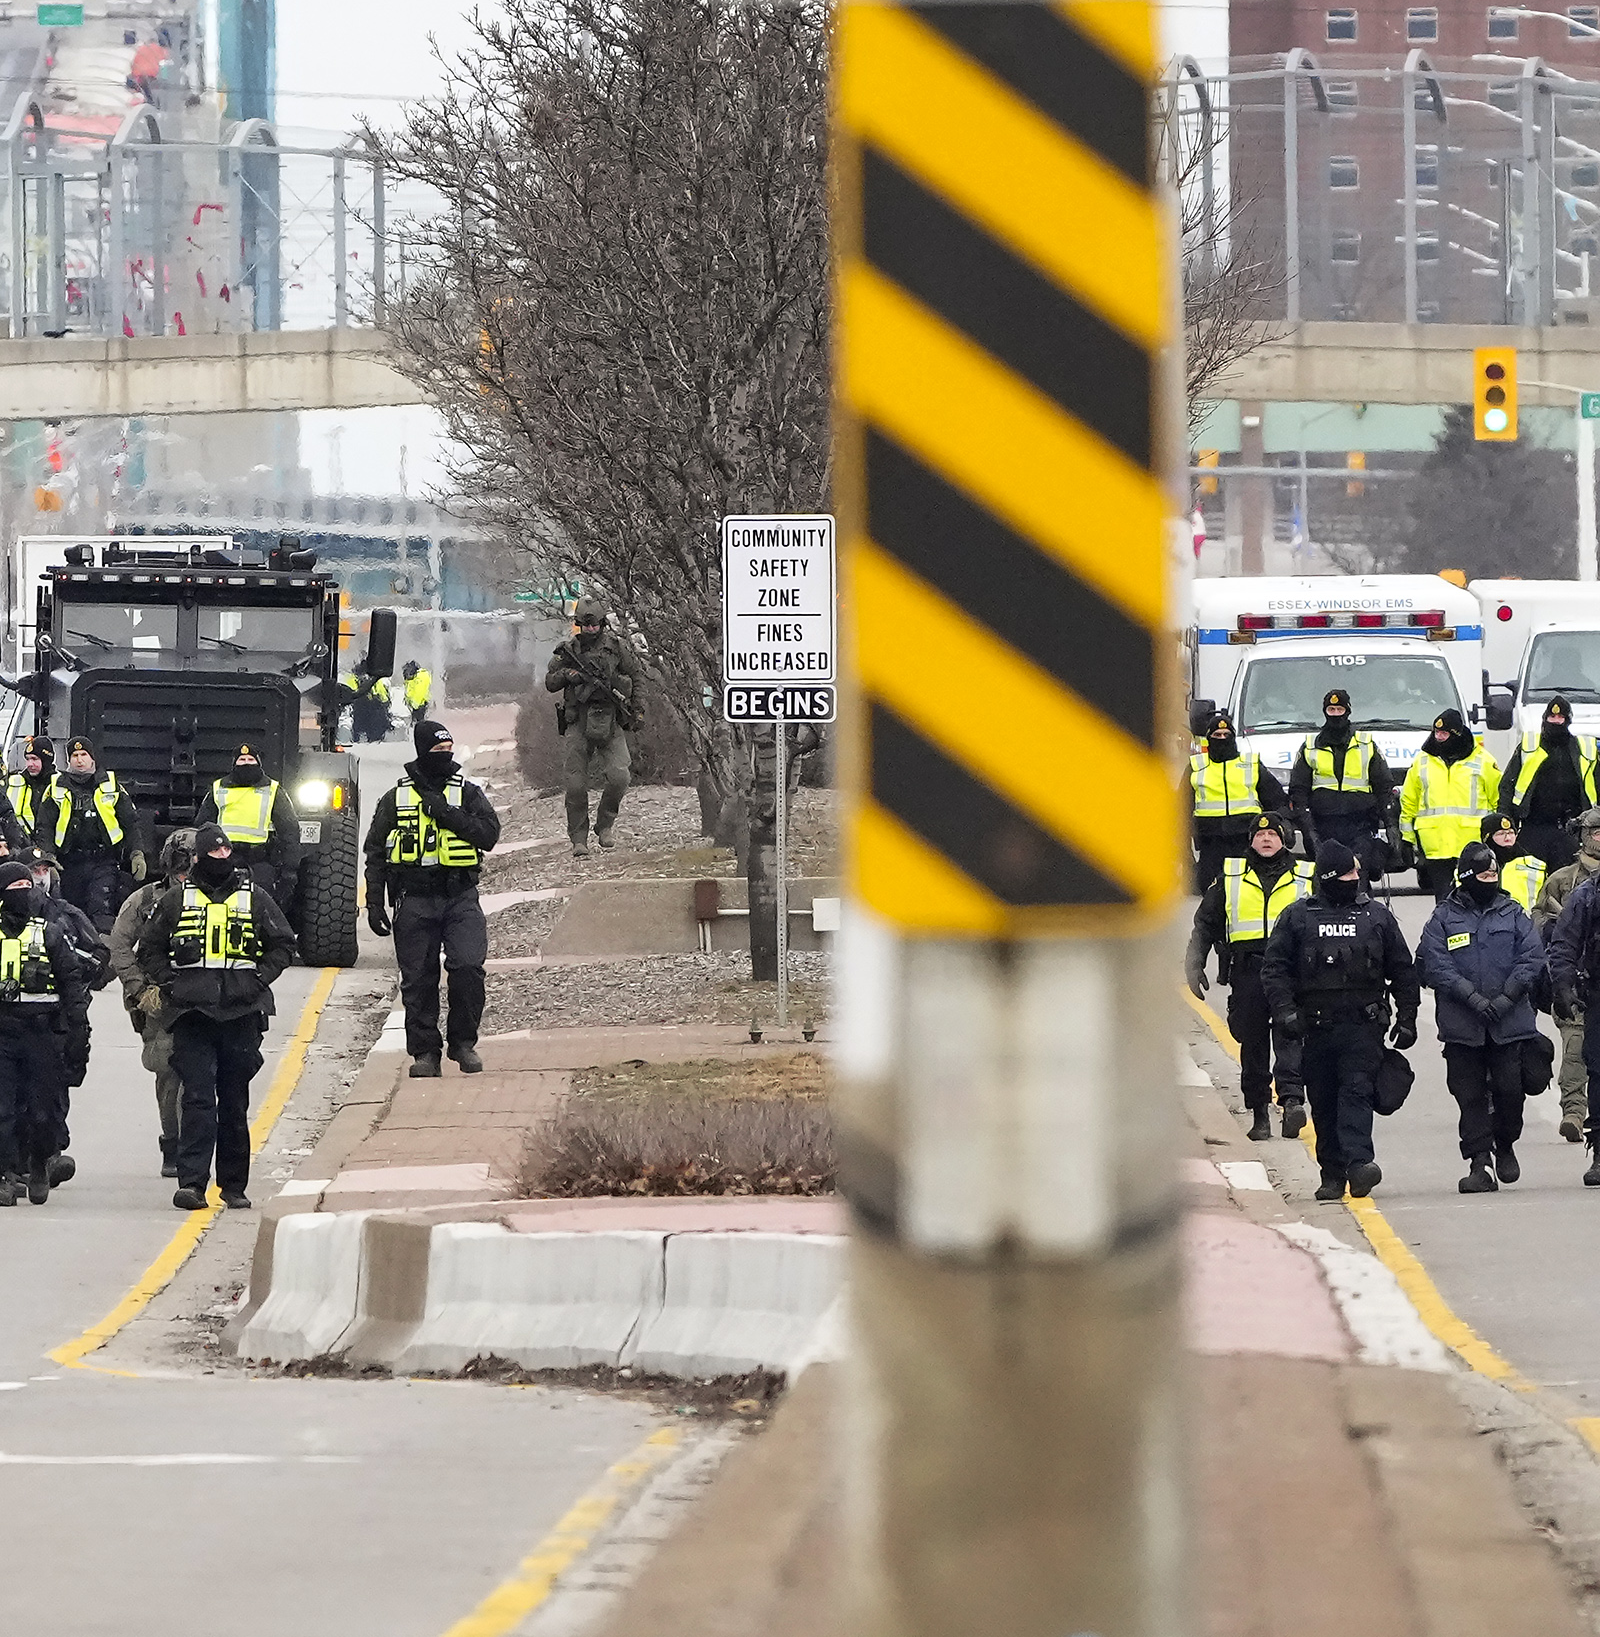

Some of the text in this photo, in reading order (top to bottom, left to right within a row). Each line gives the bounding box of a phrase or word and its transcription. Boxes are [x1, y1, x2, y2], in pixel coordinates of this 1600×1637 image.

[731, 529, 827, 548] COMMUNITY
[749, 559, 810, 577] SAFETY
[757, 588, 801, 607] ZONE
[1268, 598, 1414, 610] ESSEX-WINDSOR EMS
[756, 623, 804, 642] FINES
[731, 651, 829, 671] INCREASED
[1328, 655, 1367, 667] 1105
[731, 691, 830, 716] BEGINS
[1318, 924, 1357, 937] POLICE
